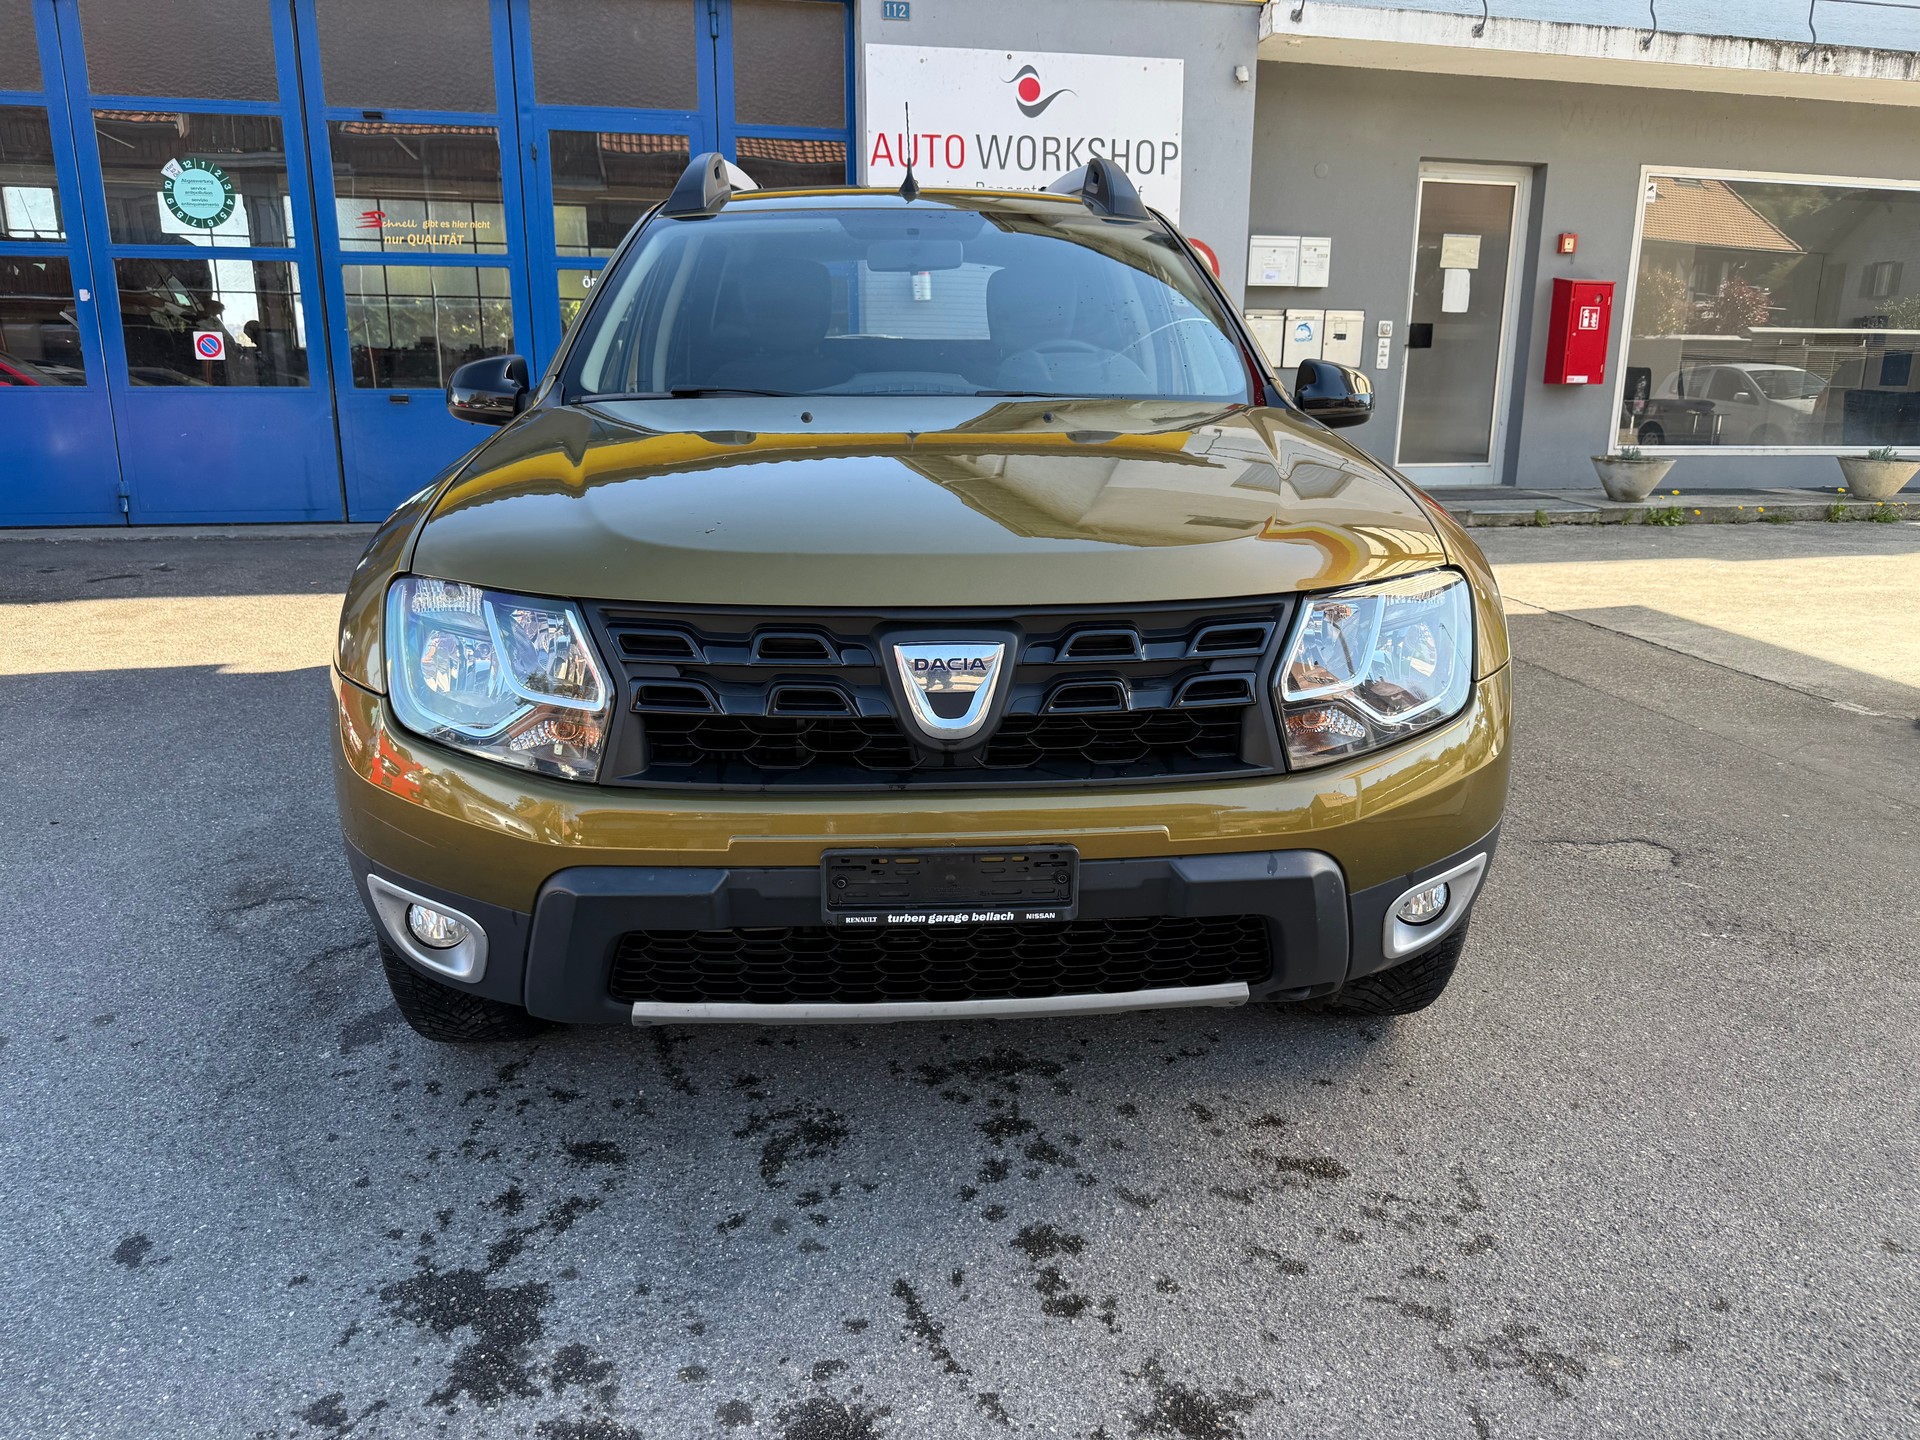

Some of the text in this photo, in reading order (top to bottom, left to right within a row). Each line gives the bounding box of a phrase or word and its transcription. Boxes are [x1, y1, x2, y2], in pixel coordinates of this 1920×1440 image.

[885, 3, 906, 17] 112
[869, 132, 1179, 175] AUTO WORKSHOP
[183, 160, 192, 168] 12
[214, 169, 222, 178] 2
[164, 180, 173, 190] 10
[166, 197, 175, 205] 9
[176, 211, 184, 219] 8
[220, 211, 228, 219] 5
[191, 219, 197, 227] 7
[207, 219, 214, 227] 6
[422, 219, 438, 230] gibt
[440, 221, 450, 229] es
[452, 220, 468, 229] hier
[470, 220, 491, 229] nicht
[384, 232, 465, 247] nur QUALITÄT
[914, 657, 987, 671] DACIA
[845, 911, 1056, 924] RENAULT turben garage bellach NISSAN
